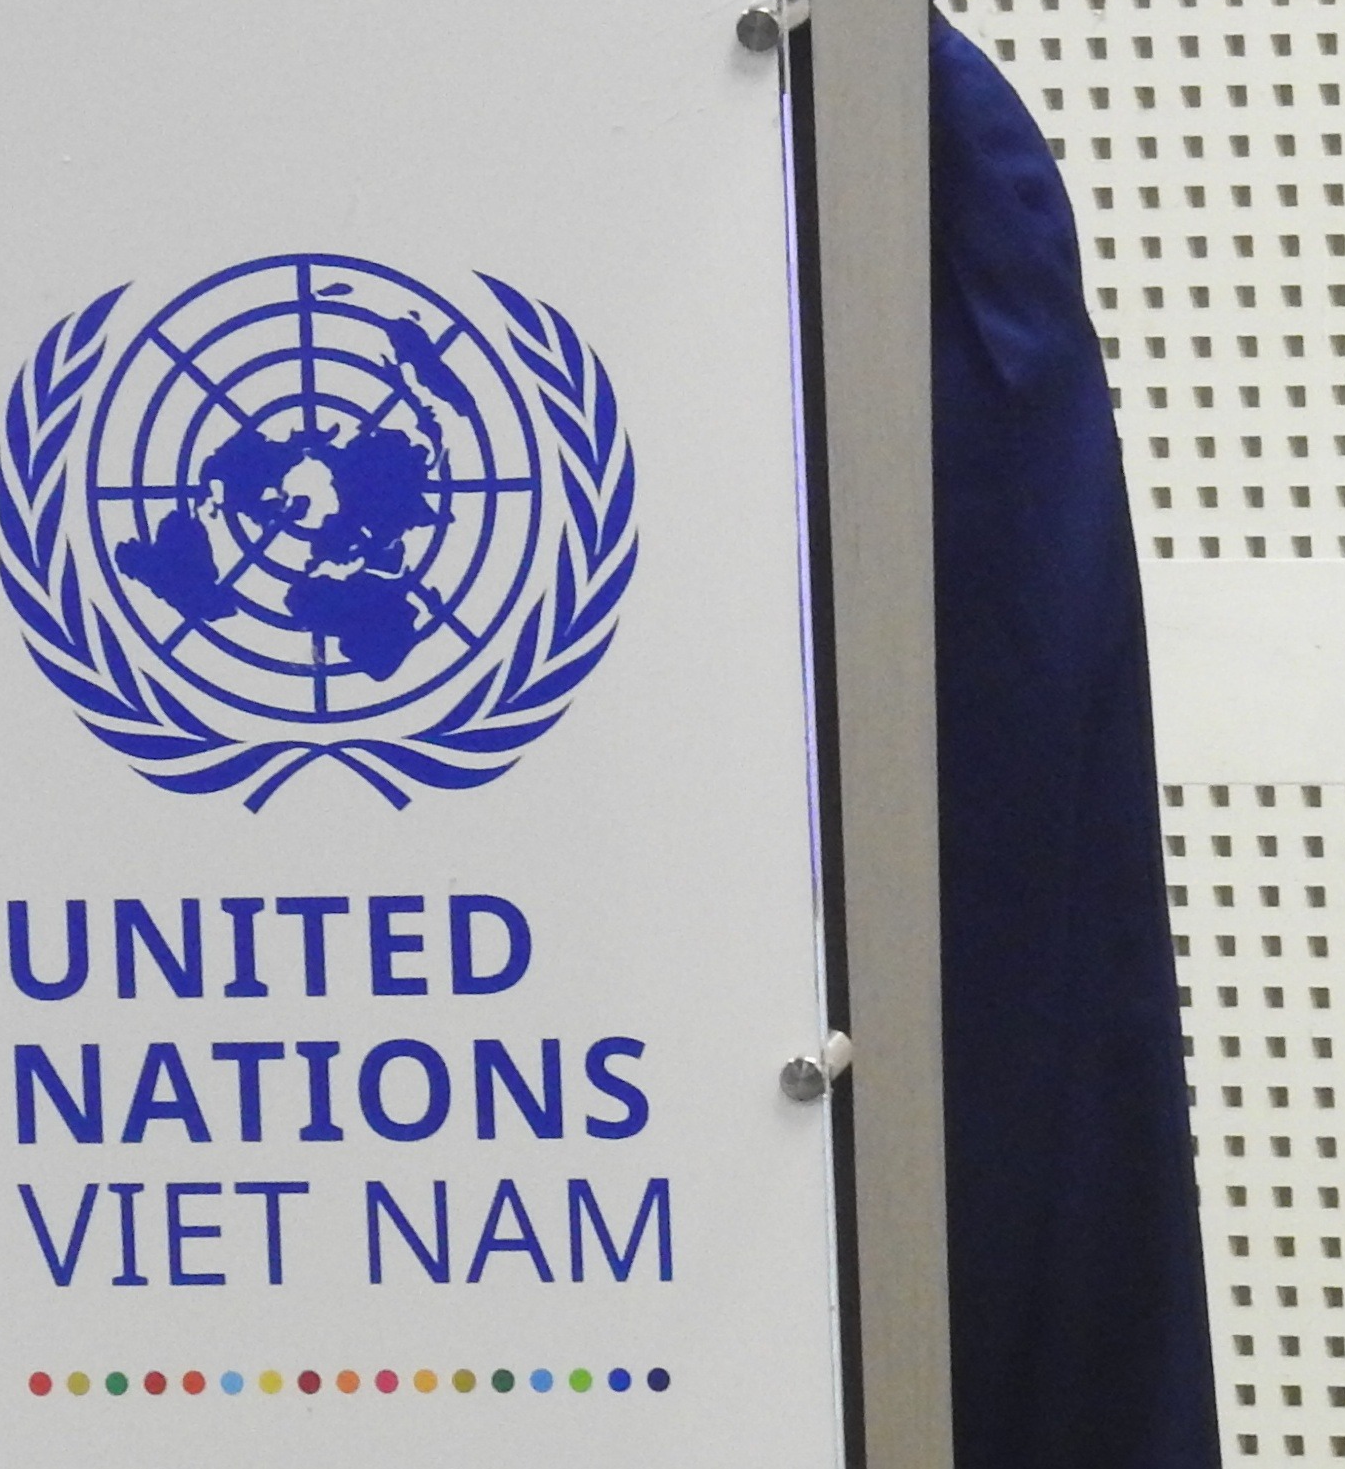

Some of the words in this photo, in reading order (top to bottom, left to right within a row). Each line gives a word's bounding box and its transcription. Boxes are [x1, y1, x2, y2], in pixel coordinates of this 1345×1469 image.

[7, 894, 532, 1001] UNITED
[14, 1037, 649, 1144] NATIONS
[17, 1180, 310, 1287] VIET
[365, 1177, 675, 1284] NAM
